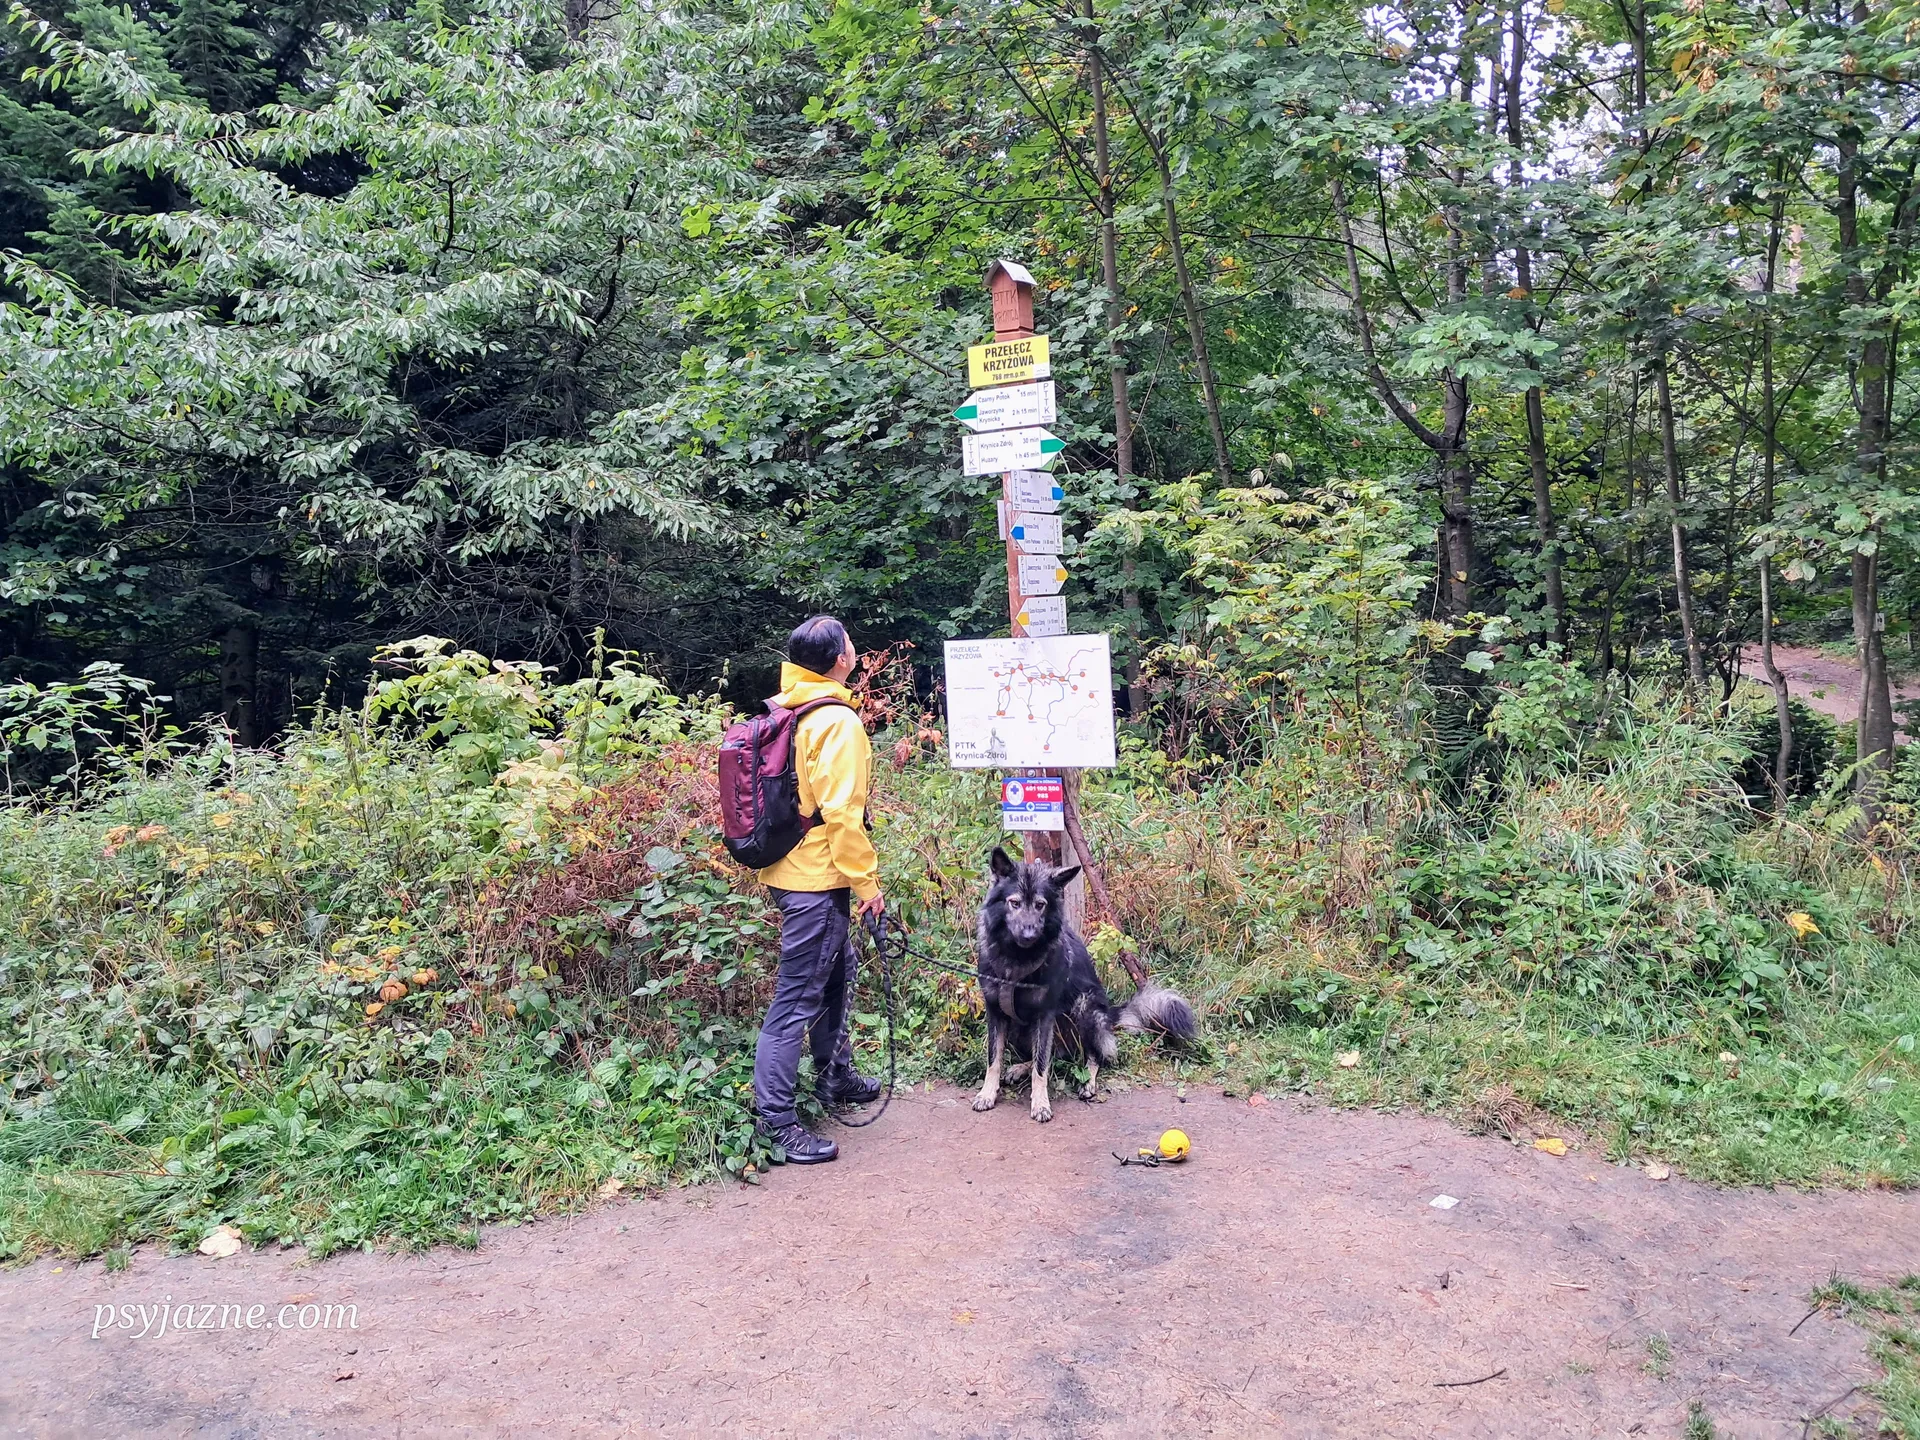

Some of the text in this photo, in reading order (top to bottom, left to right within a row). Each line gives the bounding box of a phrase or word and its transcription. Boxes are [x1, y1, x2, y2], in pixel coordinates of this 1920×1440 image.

[993, 289, 1017, 305] PTTK
[985, 341, 1032, 359] PRZEŁĘCZ
[983, 354, 1034, 373] KRZYŻOWA
[996, 393, 1010, 401] Potok
[979, 408, 1005, 416] Jaworzyna
[979, 416, 1001, 425] Krynicka
[980, 442, 999, 450] Krynica
[1023, 451, 1029, 459] 45
[955, 751, 1007, 761] Krynica-Zdrój
